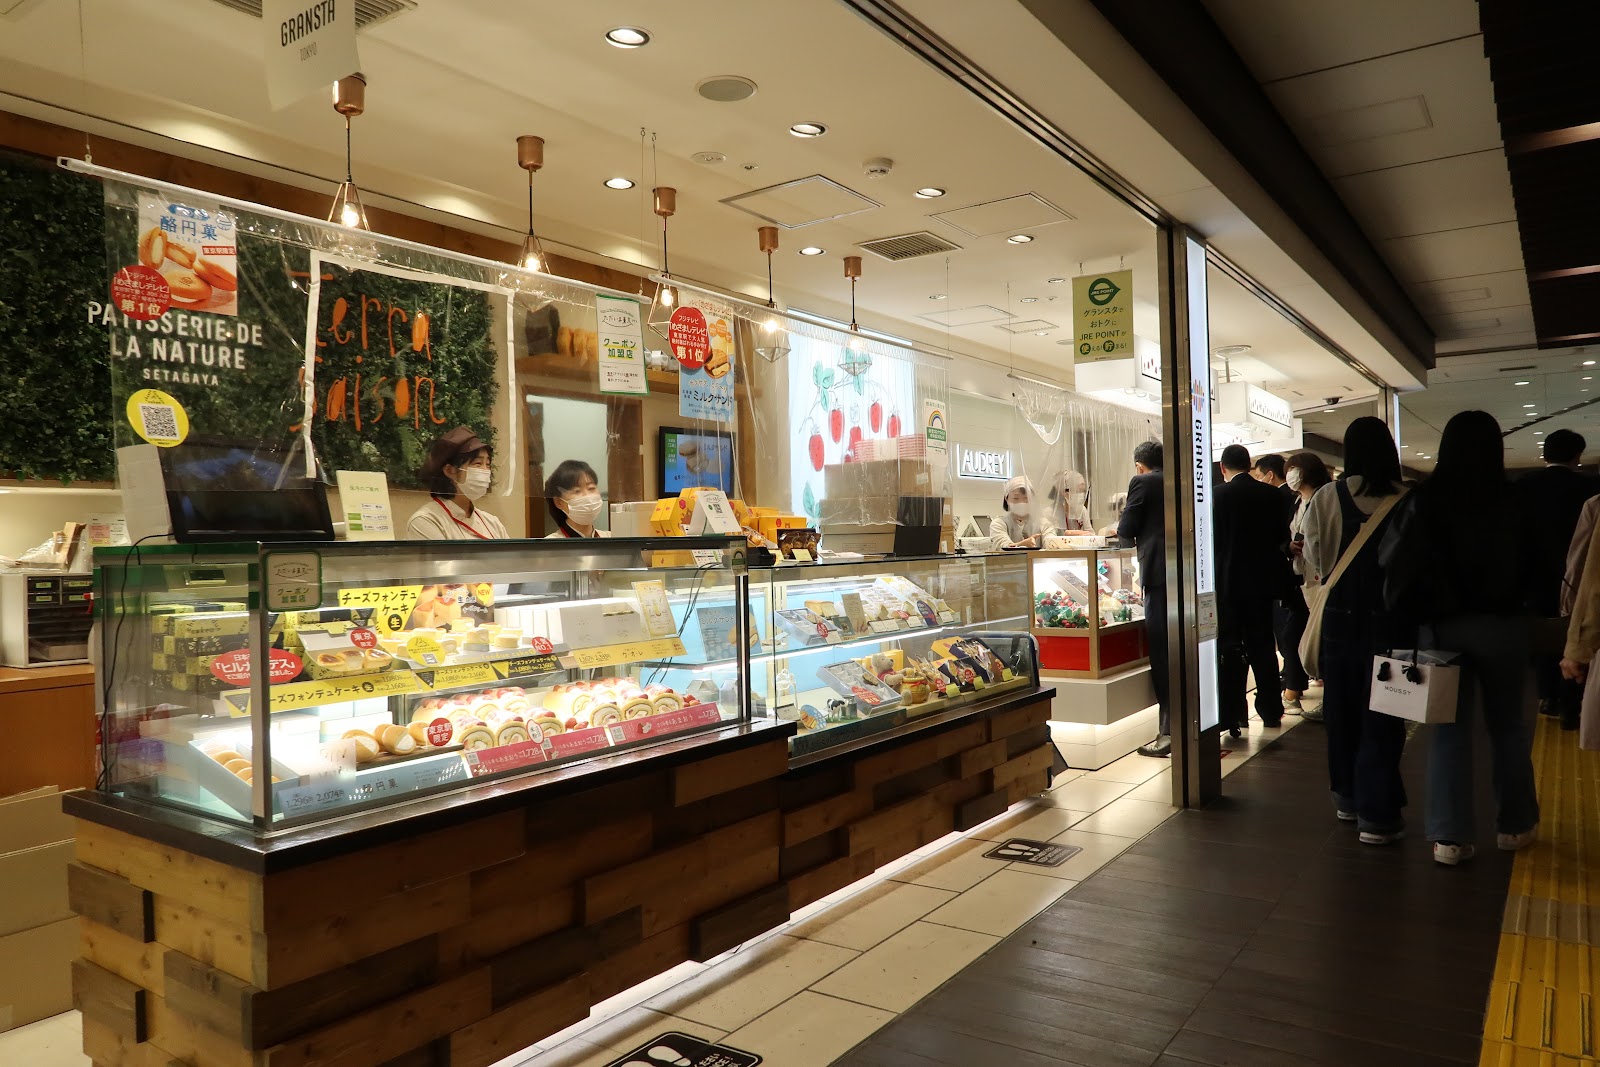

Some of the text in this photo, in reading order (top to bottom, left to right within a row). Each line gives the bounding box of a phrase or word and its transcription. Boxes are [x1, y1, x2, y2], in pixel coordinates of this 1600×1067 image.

[280, 0, 336, 47] GRANSTA
[300, 42, 317, 61] TOKYO
[160, 215, 218, 241] 酪円菓
[121, 299, 161, 316] 第1位
[1083, 306, 1124, 318] グランスタで
[678, 315, 699, 324] フジテレビ
[1090, 319, 1117, 329] おトクに
[237, 322, 263, 346] DE
[669, 322, 708, 337] 「めざましテレビ」
[1079, 333, 1094, 342] JRE
[1095, 329, 1120, 340] POINT
[603, 338, 637, 349] クーポン
[111, 333, 246, 370] LA NATURE
[607, 348, 634, 359] 加盟店
[676, 345, 704, 362] 第1位
[143, 368, 219, 386] SETAGAYA
[693, 390, 733, 407] ミルクサンド
[962, 449, 1005, 475] AUDREY
[1195, 418, 1204, 503] GRANSTA
[278, 587, 310, 596] クーポン
[342, 588, 417, 605] チーズフォンデュ
[382, 603, 409, 616] ケーキ
[390, 617, 401, 629] 生
[352, 631, 373, 642] 東京
[215, 658, 296, 673] 「ヒルナデス」
[269, 684, 361, 704] ーズフォンデュケーキ
[1384, 686, 1412, 696] MOUSSY
[428, 722, 453, 736] 東京駅
[433, 733, 449, 744] 限定
[362, 778, 398, 795] 酪円菓
